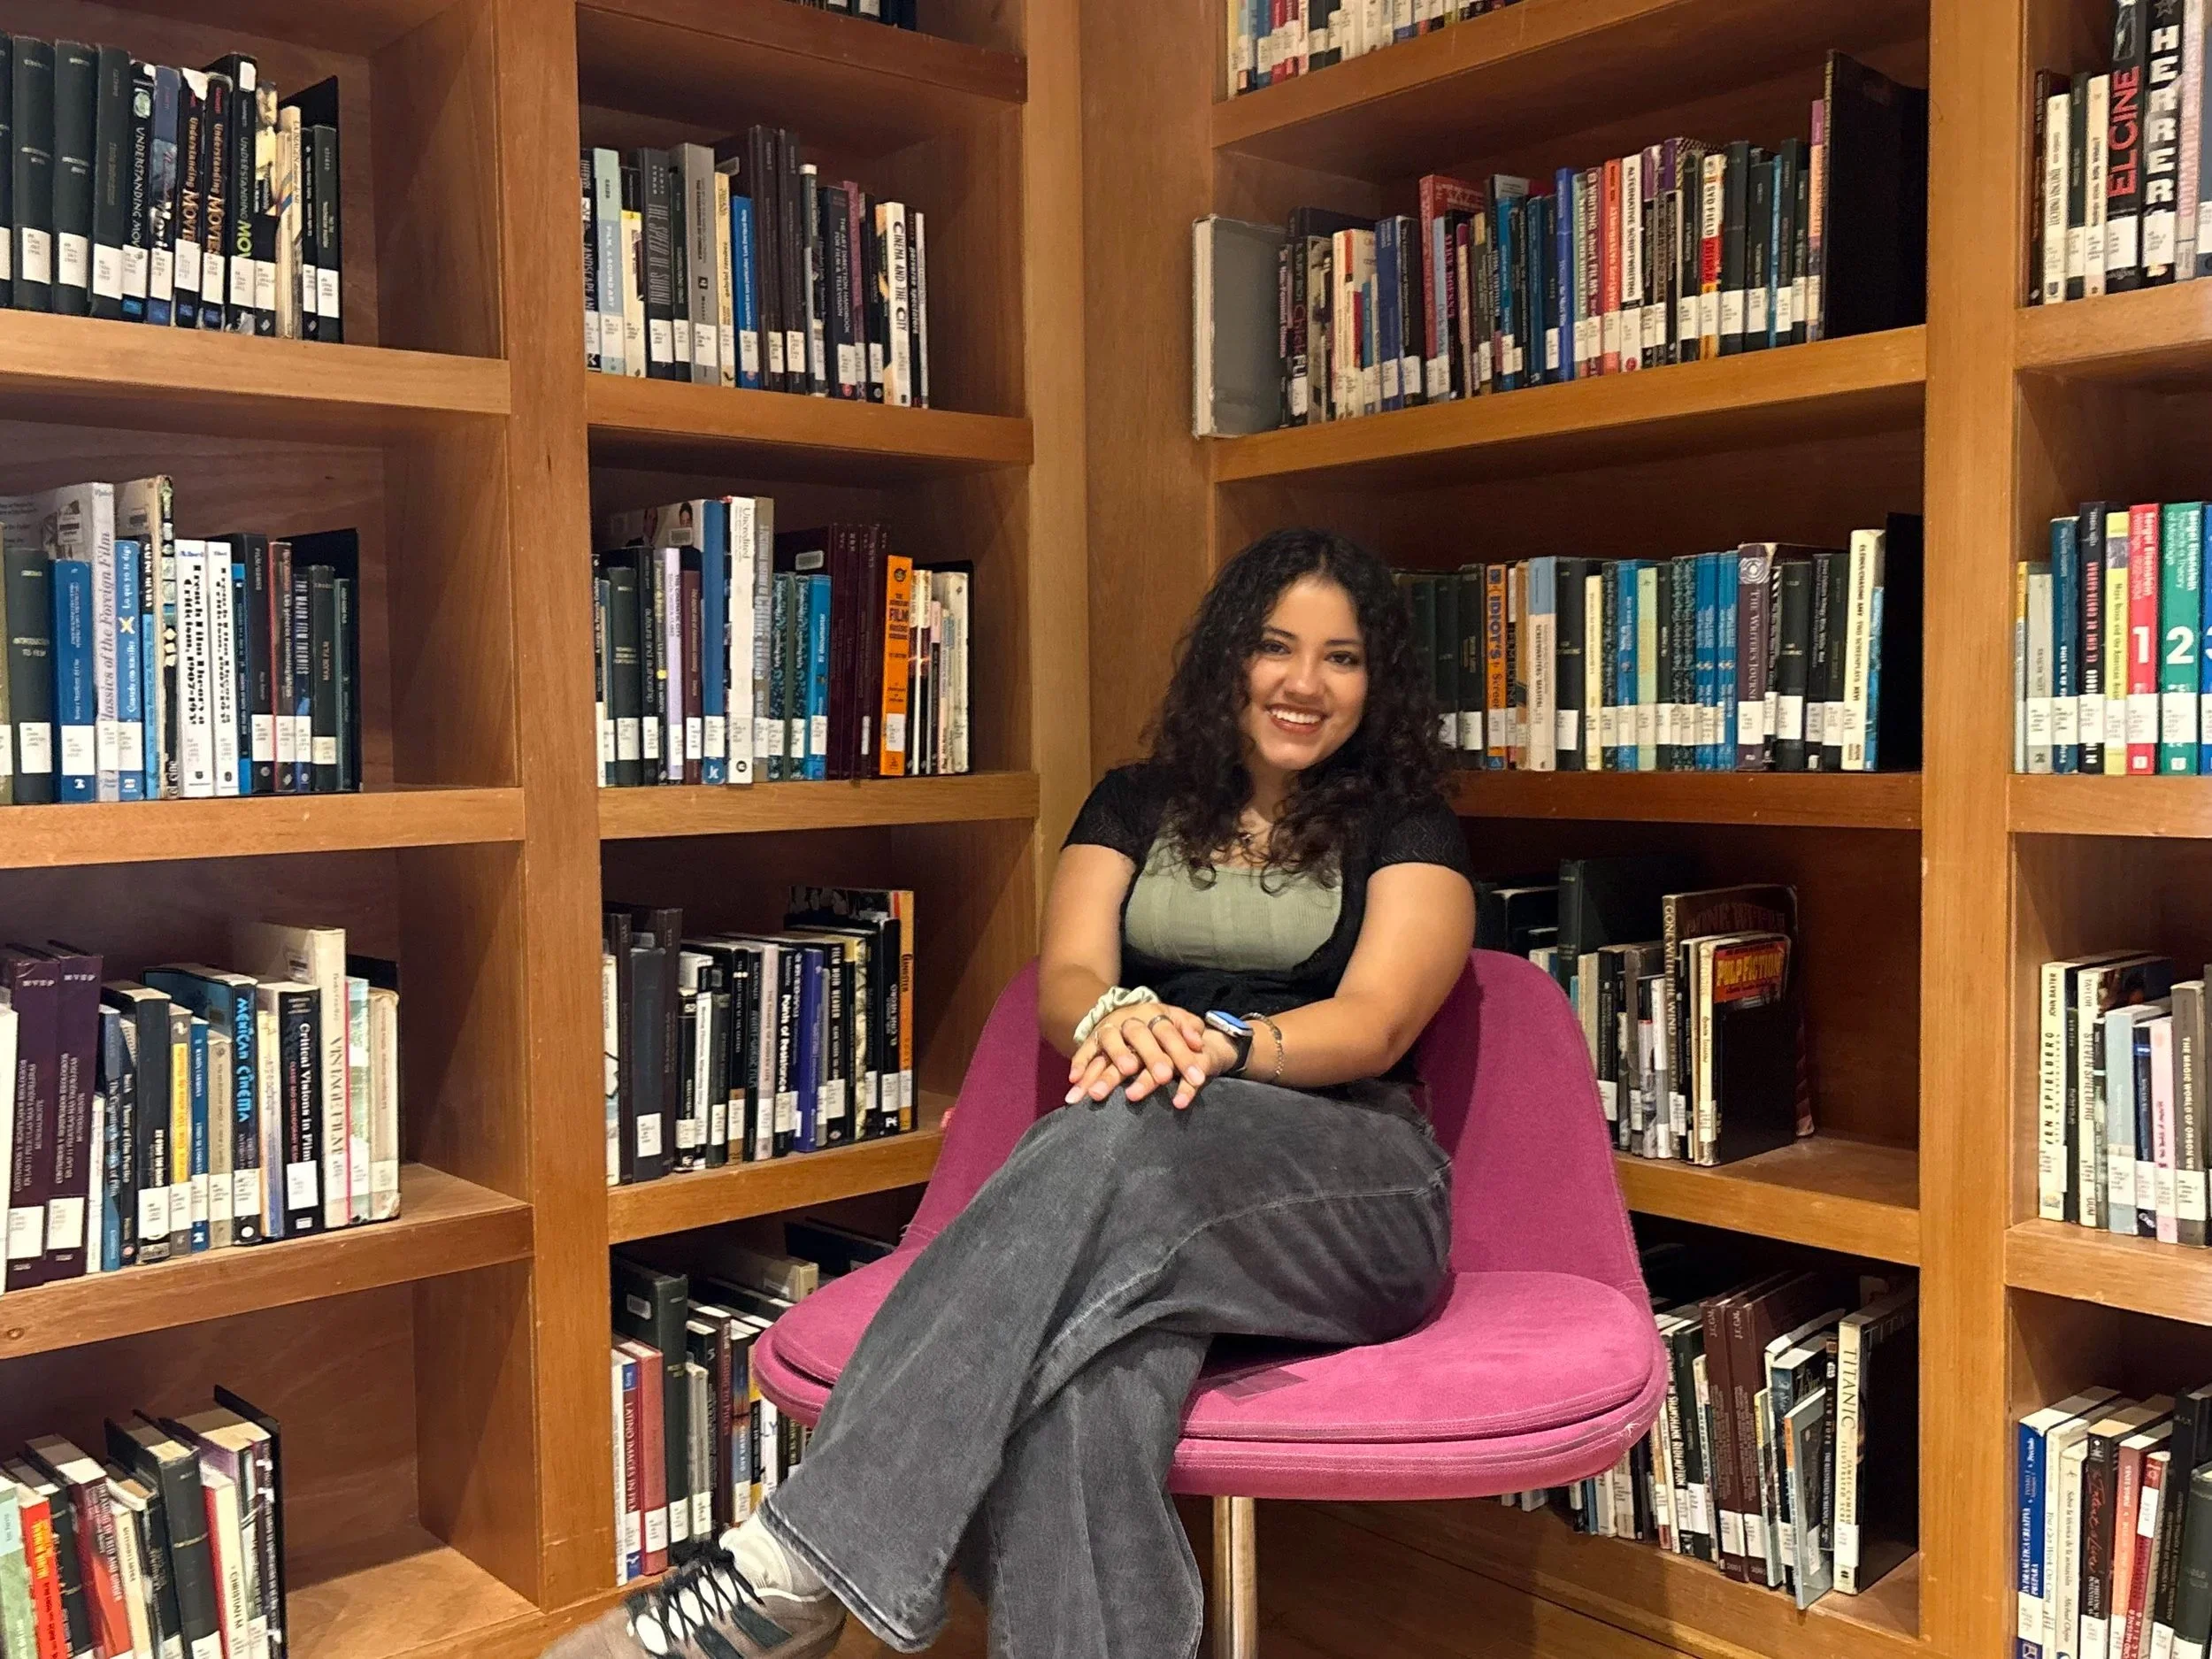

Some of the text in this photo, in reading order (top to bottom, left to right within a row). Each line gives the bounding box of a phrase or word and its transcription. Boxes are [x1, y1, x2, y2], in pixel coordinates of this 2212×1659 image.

[2106, 65, 2140, 198] EL CINE
[132, 127, 145, 217] UNDERSTANDING
[212, 123, 223, 194] Understanding
[239, 137, 250, 219] UNDERSTANDING
[1587, 184, 1599, 296] WRITING short FILMS
[1627, 165, 1636, 297] ALTERNATIVE SCRIPTWRITING
[1704, 207, 1716, 236] FIELD
[648, 204, 671, 305] THE SPEED OF SOUND
[893, 221, 906, 331] CINEMA AND THE CITY
[908, 246, 917, 287] perverse
[910, 288, 918, 334] spectators
[98, 532, 111, 567] Film
[741, 507, 752, 559] Uncredited
[99, 572, 114, 626] Foreign
[1748, 590, 1761, 611] THE
[100, 631, 113, 652] the
[295, 580, 310, 675] THE MAJOR FILM THEORIES
[646, 641, 655, 658] and
[1490, 595, 1502, 659] IDIOT'S
[1748, 614, 1760, 661] WRITER'S
[2132, 626, 2149, 664] 1
[2166, 626, 2194, 664] 2
[101, 654, 114, 669] of
[831, 947, 841, 1018] FILM NOIR READER
[902, 954, 912, 993] GANGSTER
[1665, 905, 1678, 1036] GONE WITH THE WIND
[778, 994, 791, 1093] Points of Resistance
[2083, 1033, 2095, 1068] STEVEN
[2182, 1037, 2192, 1054] THE
[329, 1036, 343, 1109] VINTAGE
[2182, 1055, 2193, 1082] MAGIC
[122, 1103, 132, 1128] Theory
[299, 1023, 313, 1163] Critical Visions in Film
[2083, 1071, 2095, 1121] SPIELBERG
[2184, 1083, 2193, 1113] WORLD
[2184, 1115, 2193, 1125] OF
[2185, 1127, 2194, 1156] ORSON
[123, 1138, 132, 1154] Film
[1840, 1348, 1857, 1430] TITANIC
[624, 1402, 635, 1440] LATINO
[1667, 1395, 1682, 1440] SHAWSHANK
[625, 1440, 635, 1479] IMAGES
[1671, 1441, 1686, 1486] REDEMPTION
[626, 1479, 636, 1491] IN
